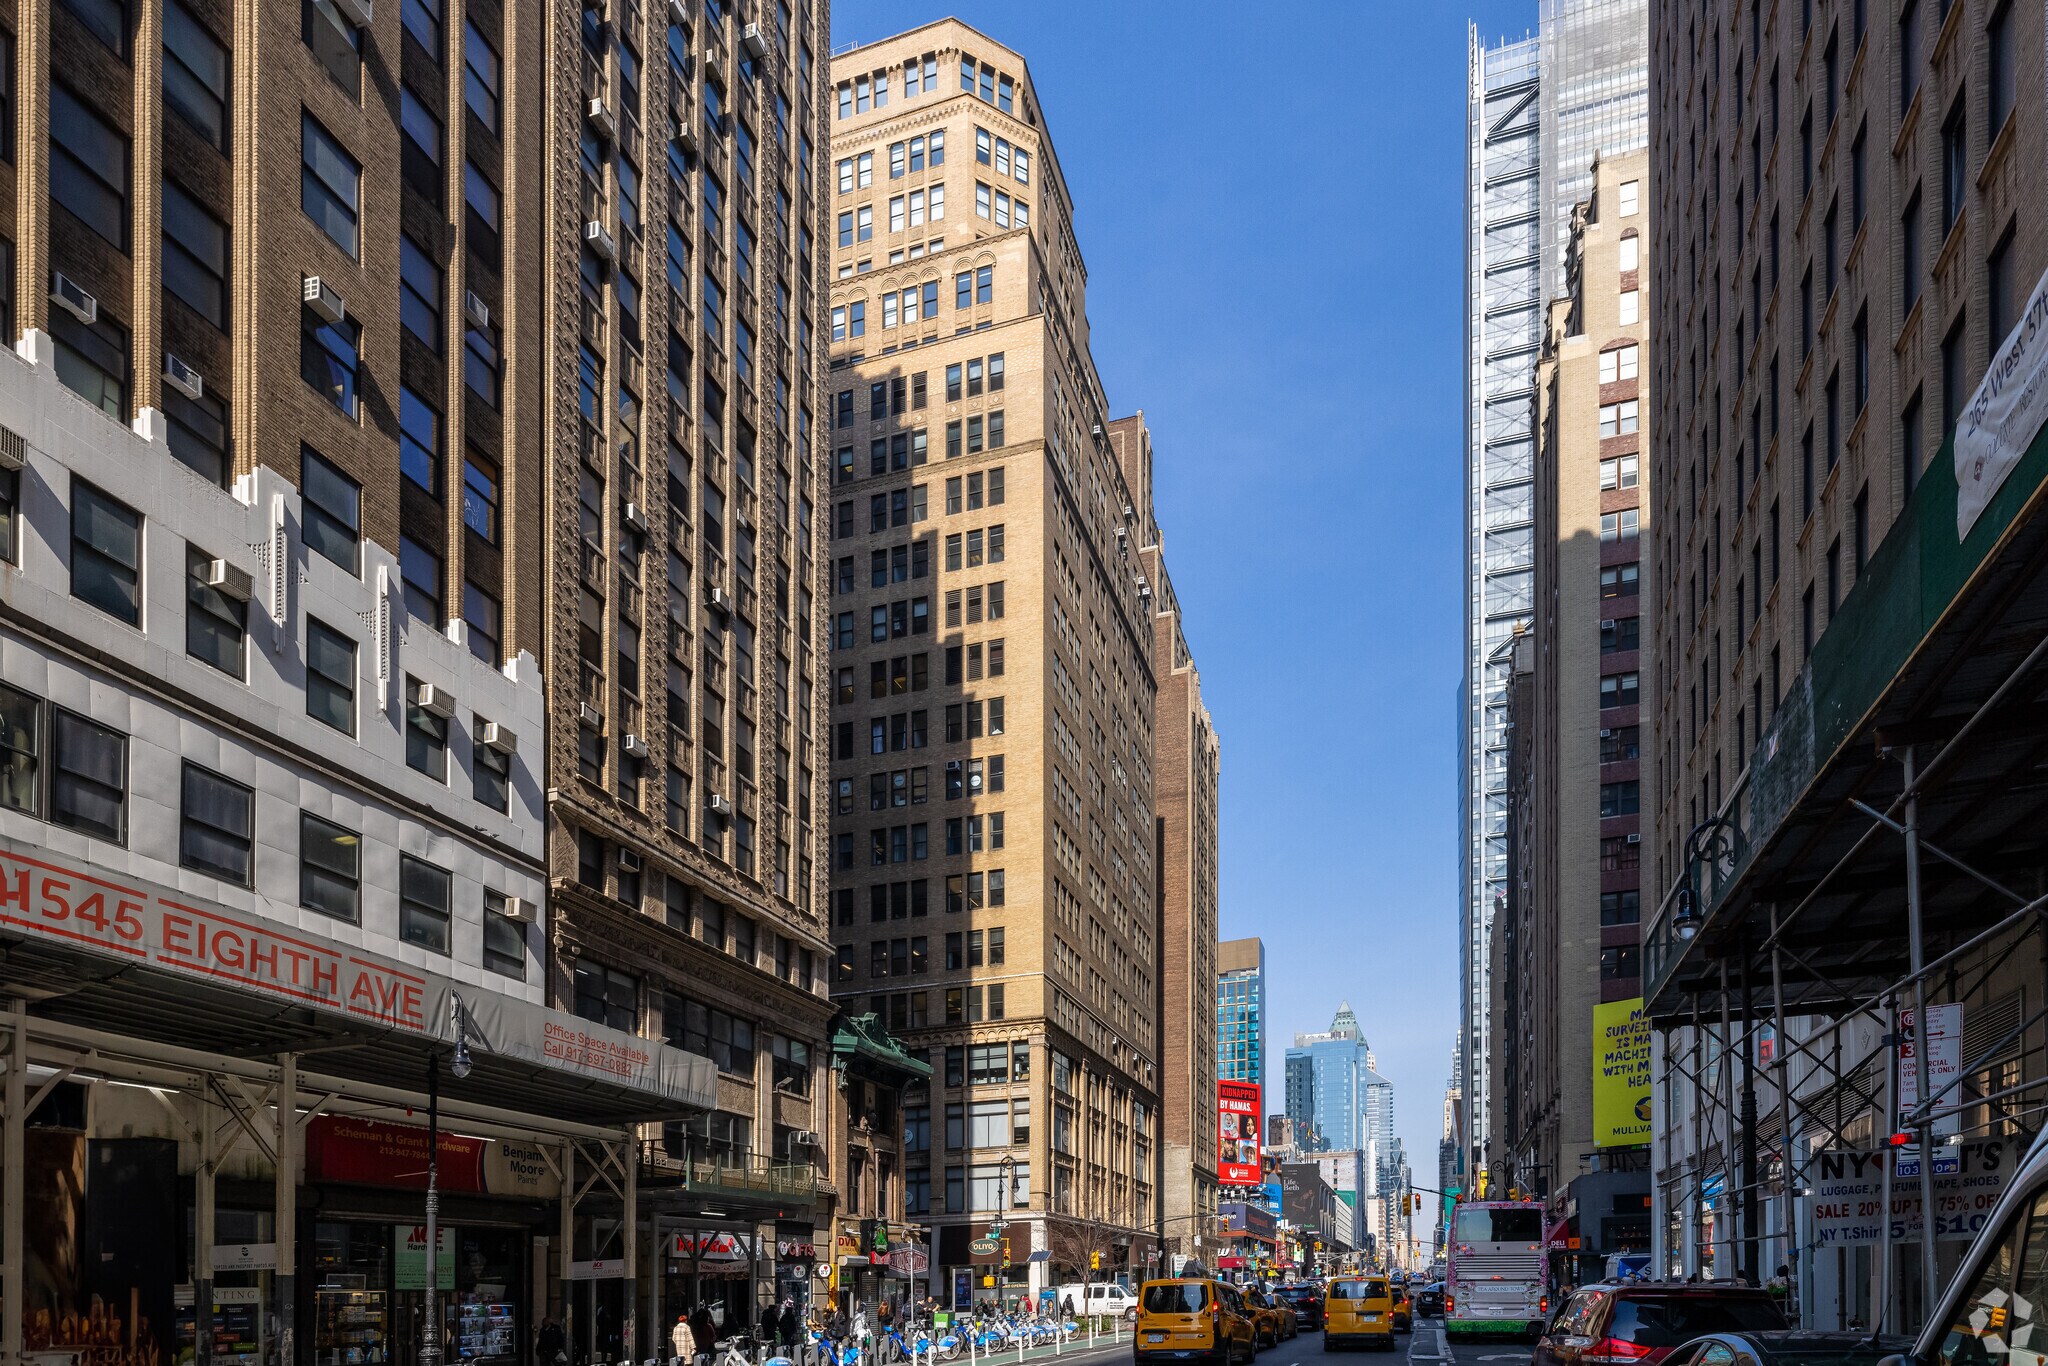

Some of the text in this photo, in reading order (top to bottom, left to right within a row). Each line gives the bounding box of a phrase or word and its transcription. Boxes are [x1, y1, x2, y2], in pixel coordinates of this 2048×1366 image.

[1967, 387, 1989, 438] 265
[1990, 335, 2026, 397] West
[162, 913, 338, 996] EIGHTH
[349, 971, 426, 1019] AVE
[544, 1022, 649, 1063] Office Space Available
[1616, 1037, 1630, 1049] IS
[544, 1040, 632, 1076] Call 917-697-0882
[1603, 1064, 1634, 1077] WITH
[1938, 1066, 1956, 1074] ONLY
[1222, 1087, 1256, 1099] KIDNAPPED
[1220, 1100, 1252, 1112] BY HAMAS.
[333, 1126, 382, 1141] Scheman
[385, 1133, 394, 1142] &
[396, 1134, 426, 1147] Grant
[510, 1160, 544, 1176] Moore
[1821, 1152, 1872, 1180] NY
[518, 1175, 537, 1185] Paints
[1875, 1181, 1921, 1193] PRFUME
[1963, 1175, 2000, 1188] SHOES
[1816, 1203, 1849, 1219] SALE
[1940, 1196, 1969, 1211] 75%
[1820, 1228, 1836, 1241] NY
[1908, 1223, 1924, 1231] FOR
[788, 1242, 815, 1258] GIFTS
[838, 1238, 856, 1247] DVD
[212, 1290, 255, 1300] NTING
